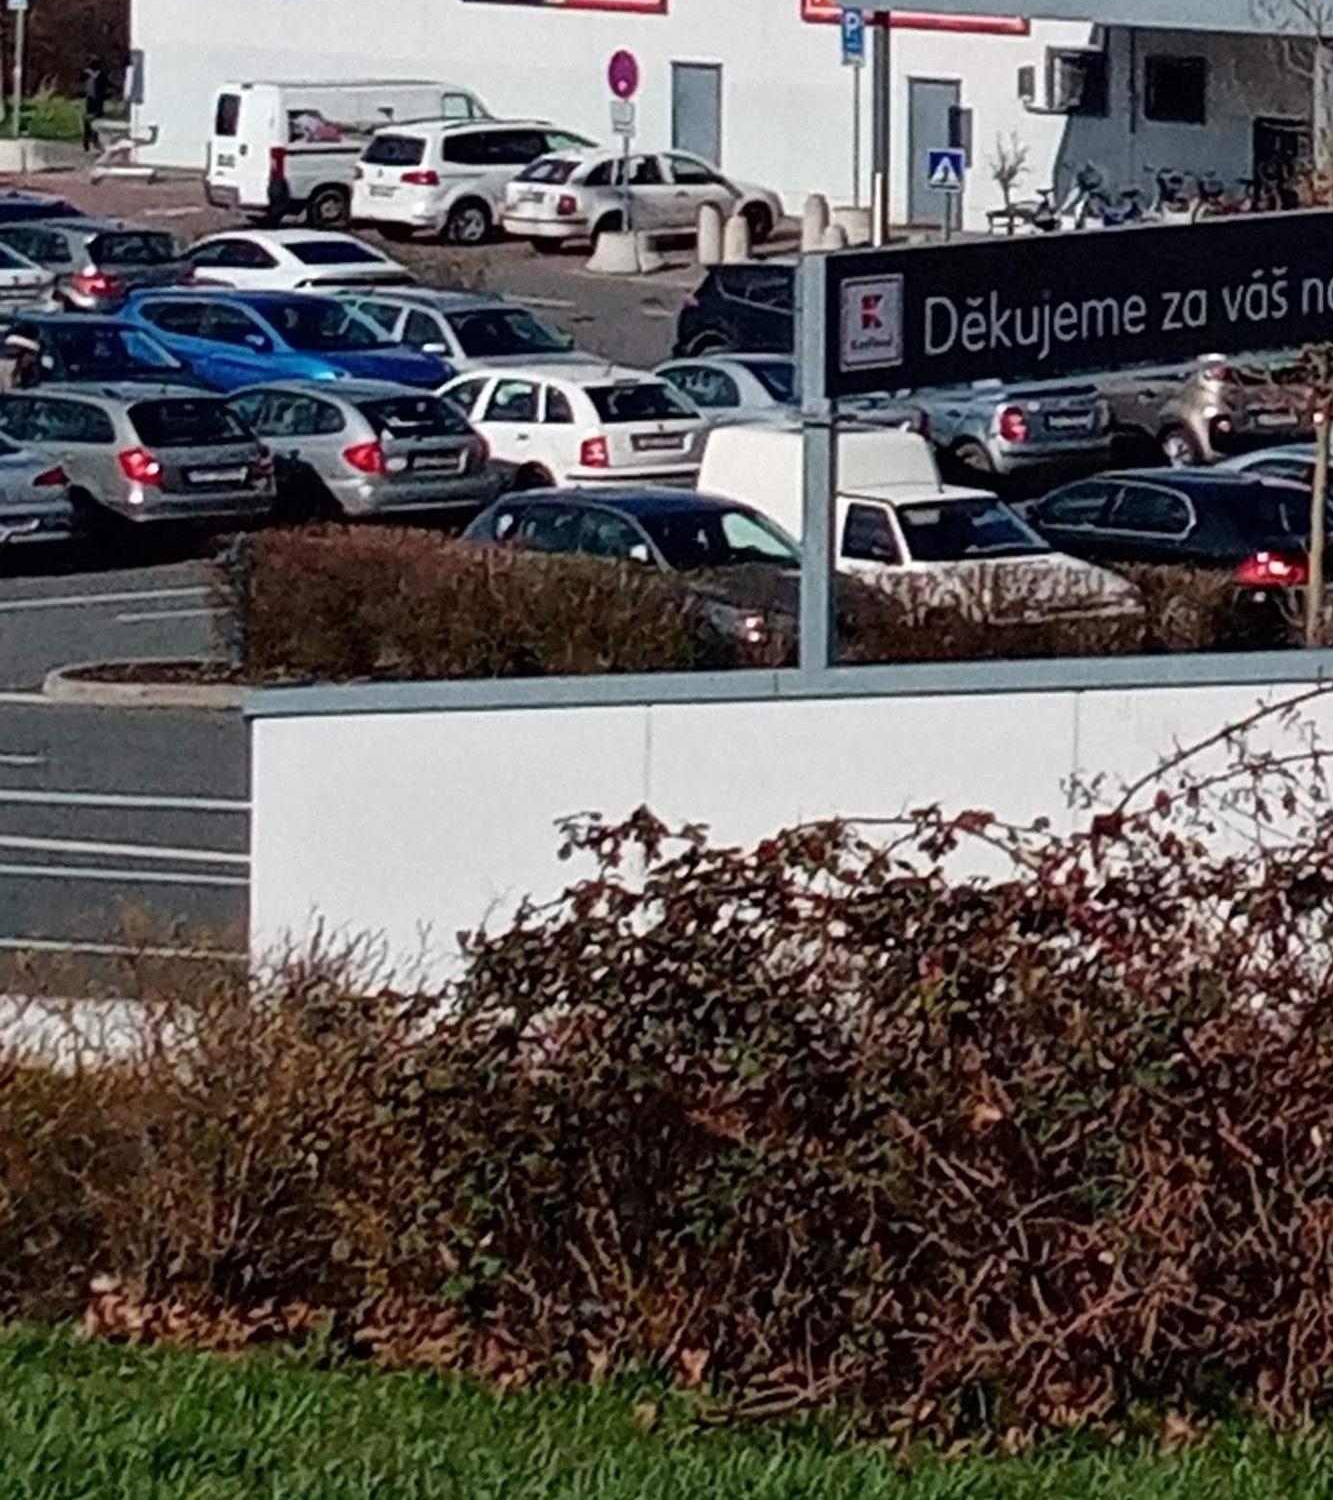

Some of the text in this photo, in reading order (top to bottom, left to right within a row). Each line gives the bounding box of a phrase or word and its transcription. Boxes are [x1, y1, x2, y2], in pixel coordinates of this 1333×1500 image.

[846, 11, 860, 39] P
[924, 290, 1147, 360] Děkujeme
[1161, 289, 1207, 331] za
[1222, 266, 1288, 322] váš
